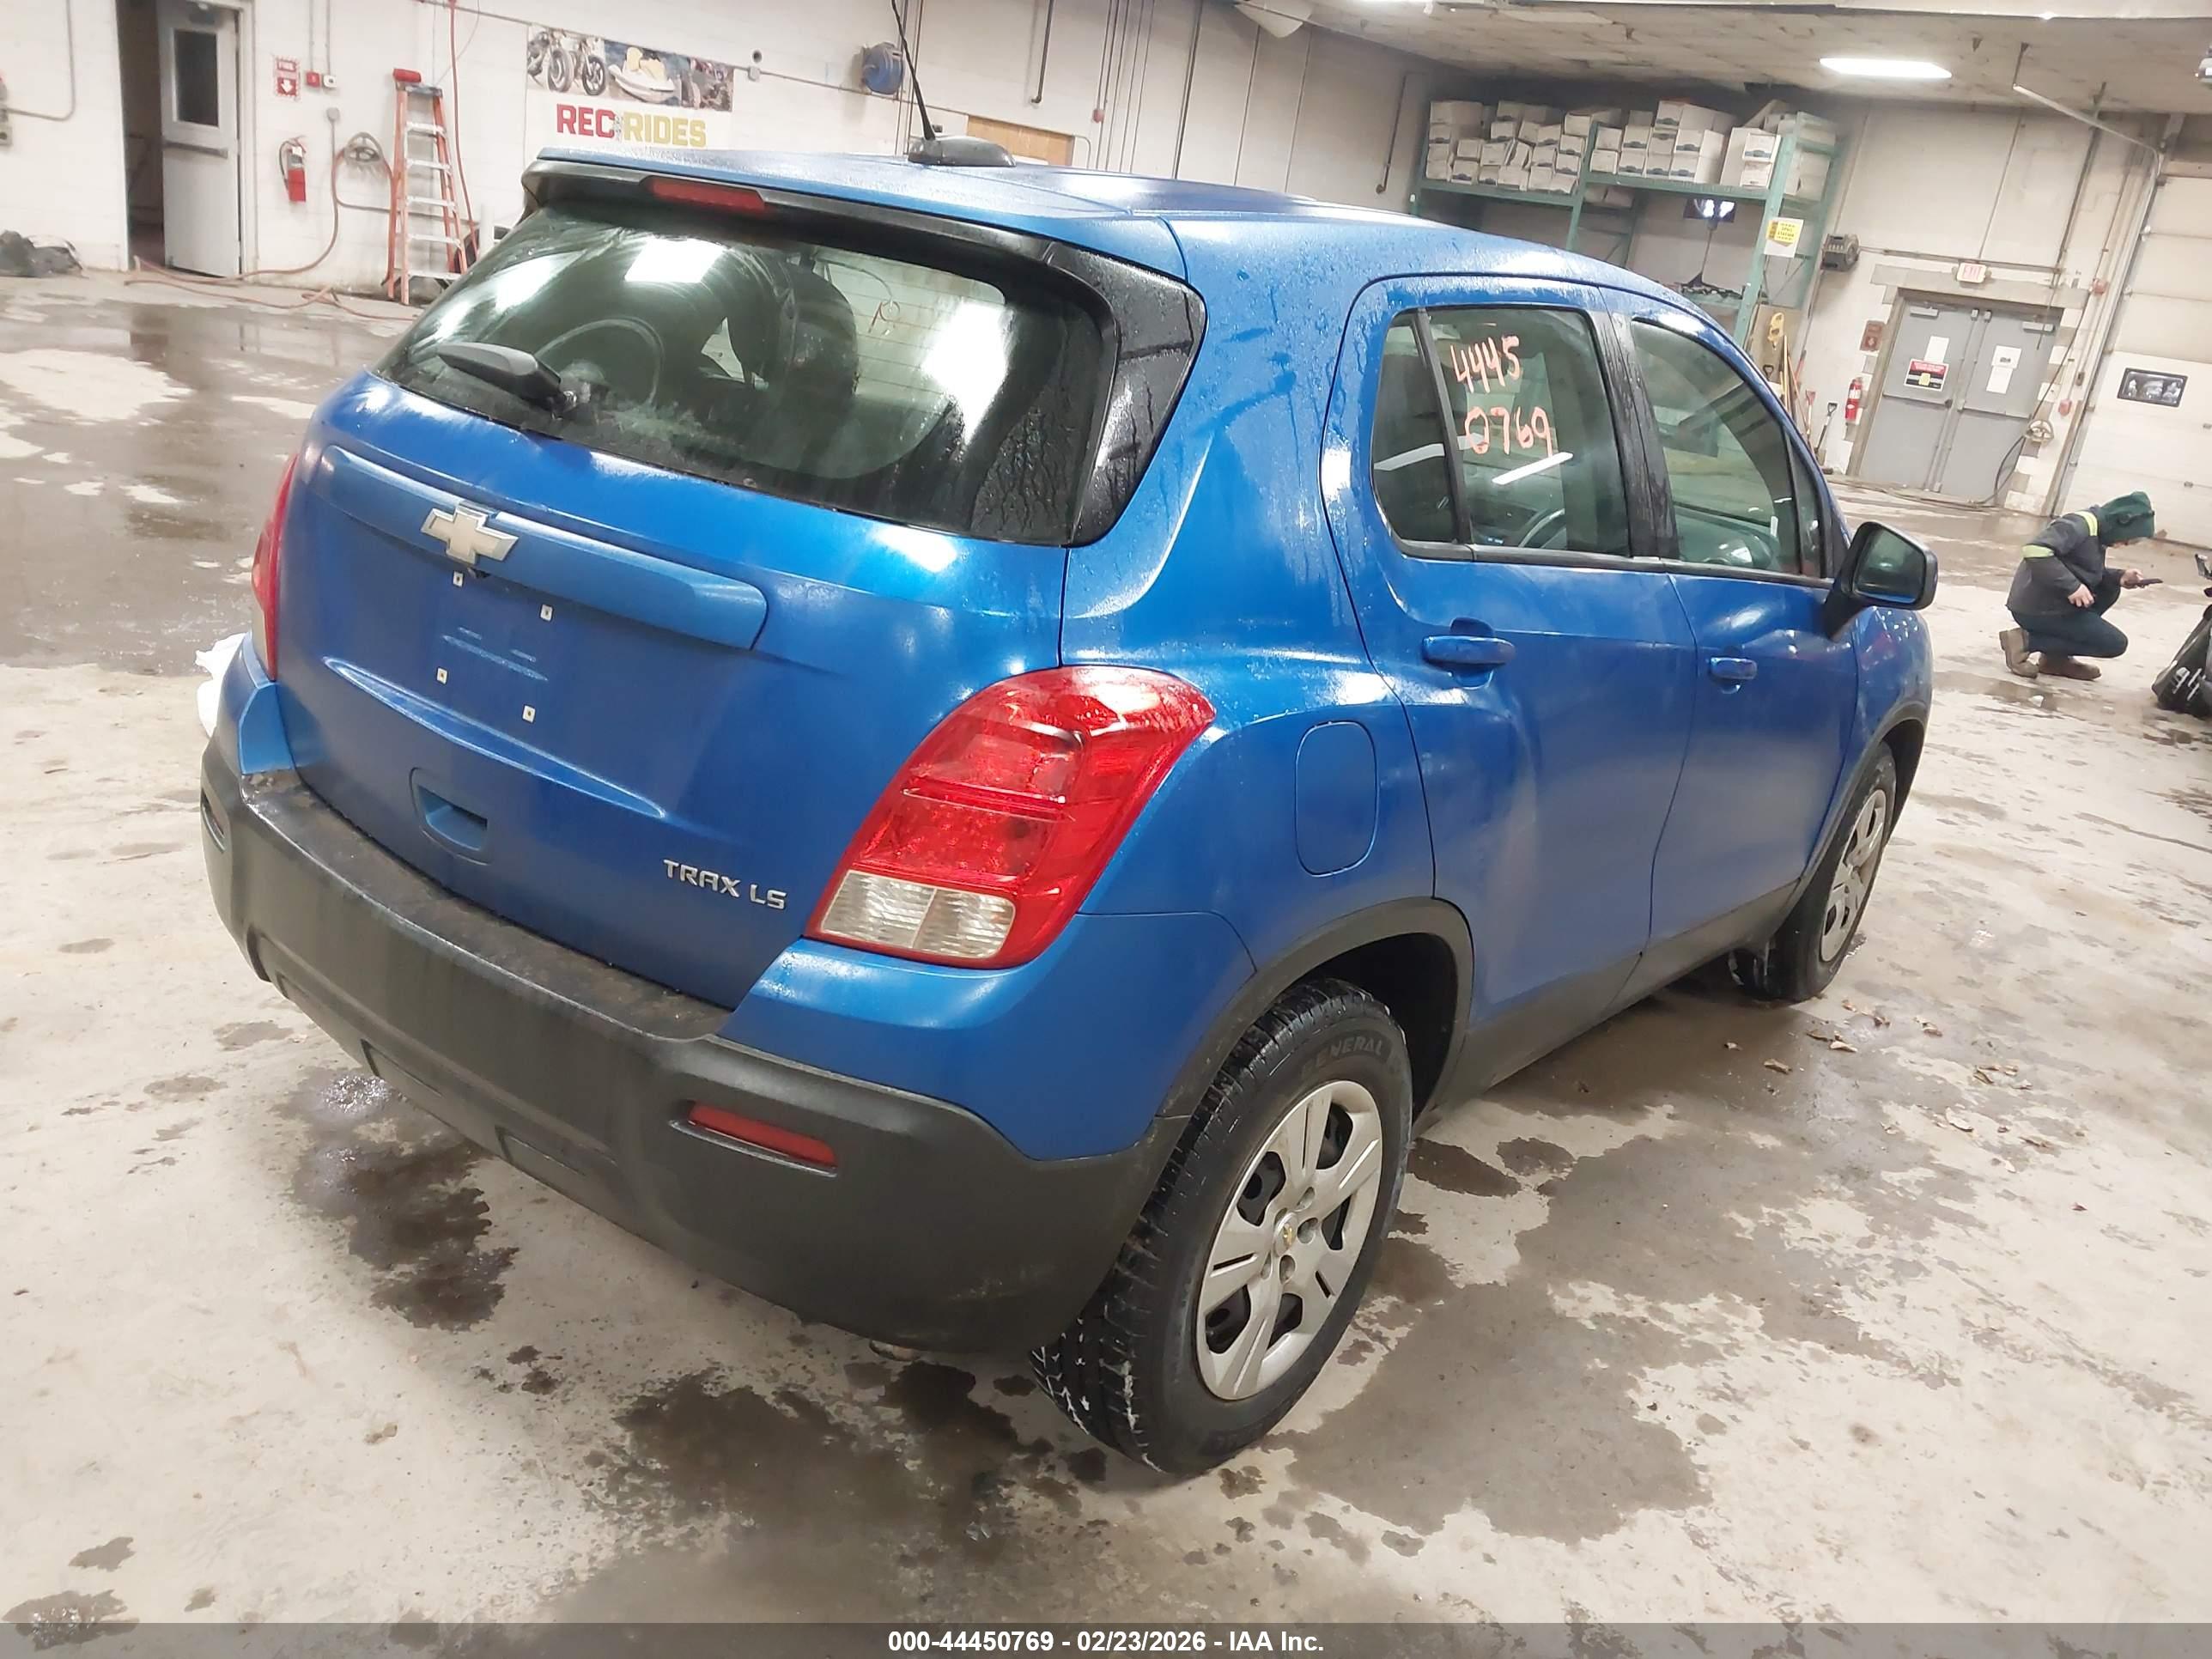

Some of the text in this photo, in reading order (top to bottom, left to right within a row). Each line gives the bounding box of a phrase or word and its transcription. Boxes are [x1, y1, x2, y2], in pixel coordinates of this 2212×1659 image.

[556, 103, 617, 139] REC
[623, 112, 708, 149] RIDES
[1449, 334, 1523, 394] 4445
[1464, 405, 1554, 459] 0769
[663, 859, 787, 910] TRAX LS
